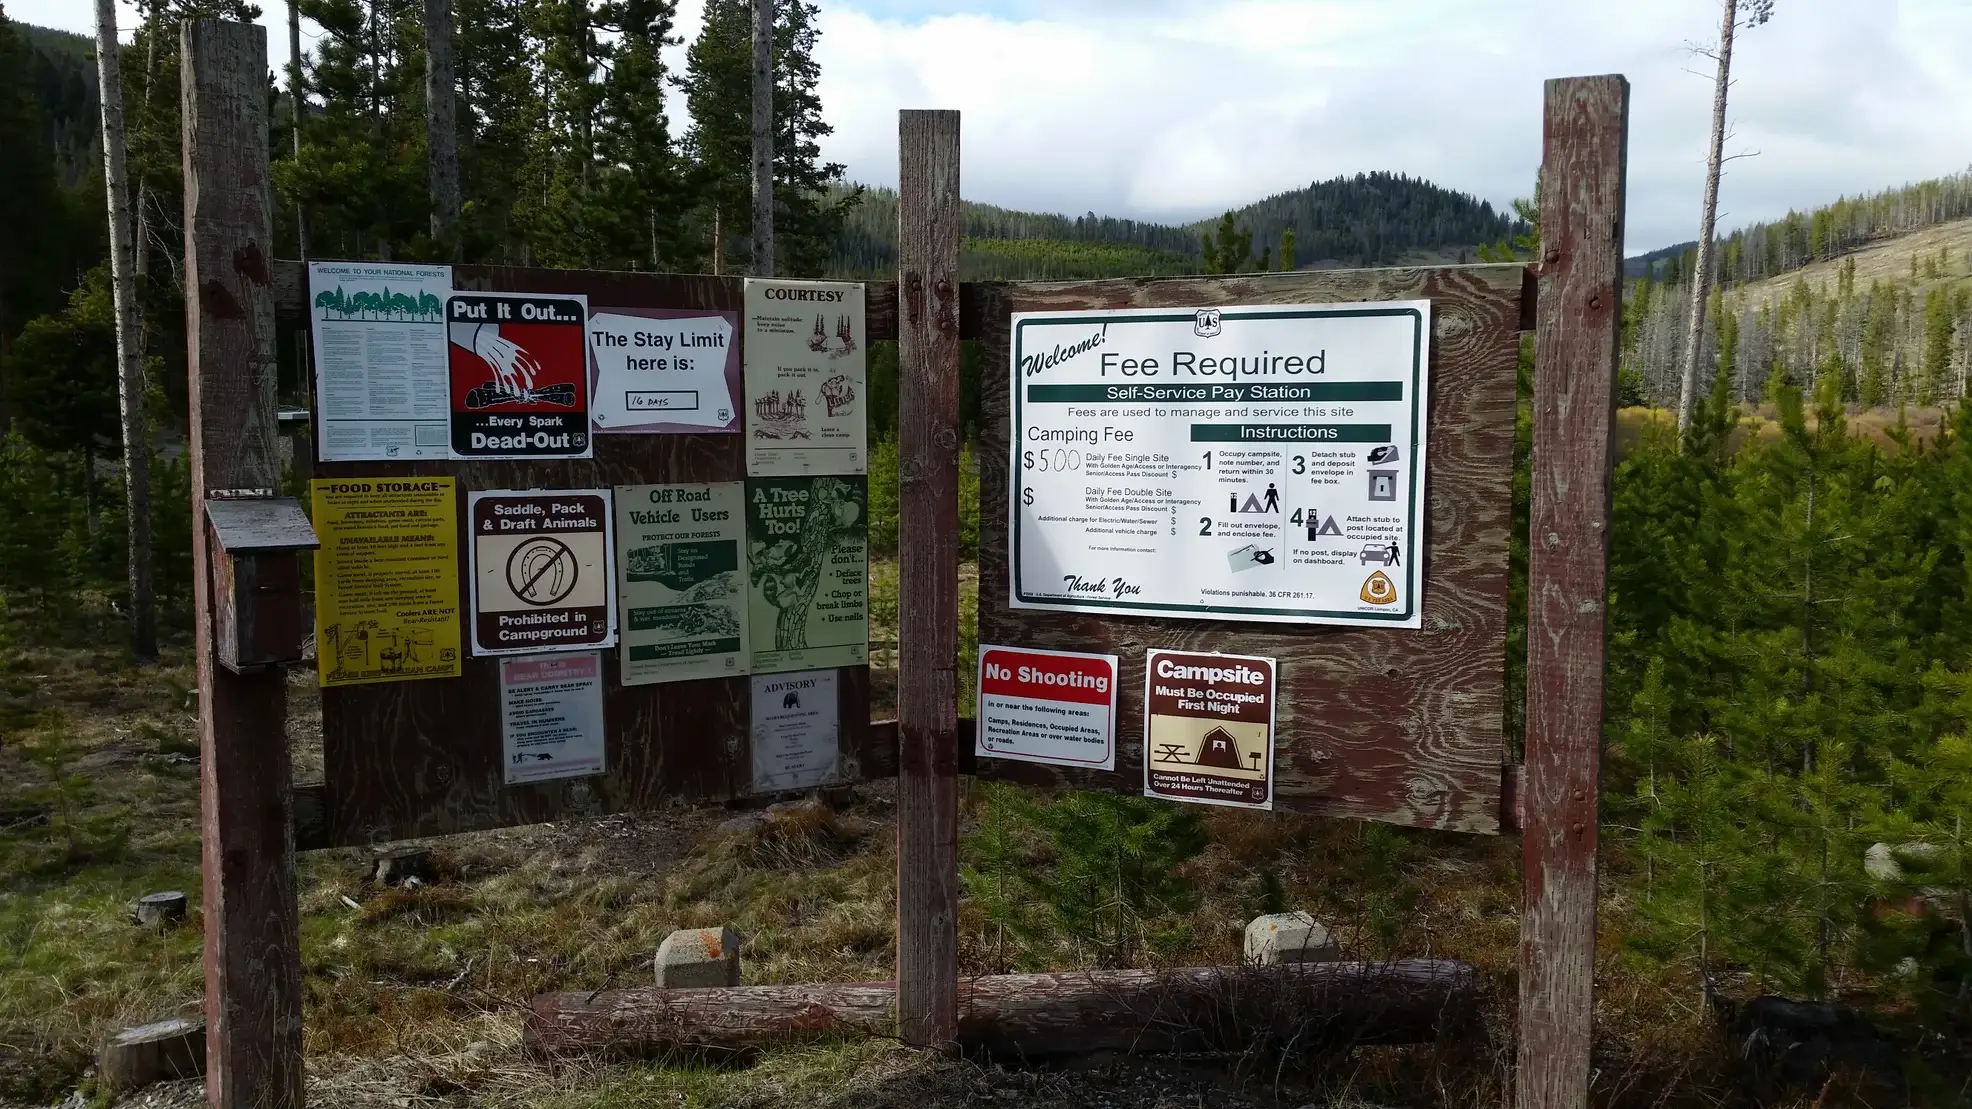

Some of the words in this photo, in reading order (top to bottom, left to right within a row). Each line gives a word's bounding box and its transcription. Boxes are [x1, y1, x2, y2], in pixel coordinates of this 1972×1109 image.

[765, 288, 844, 302] COURTESY
[453, 301, 487, 319] Put
[497, 303, 511, 319] It
[521, 303, 577, 321] Out...
[592, 331, 628, 347] The
[634, 331, 673, 351] Stay
[680, 332, 724, 347] Limit
[1022, 322, 1108, 377] Welcome!
[627, 355, 667, 370] here
[673, 355, 694, 370] is:
[1101, 352, 1159, 377] Fee
[1173, 350, 1325, 381] Required
[1107, 386, 1206, 399] Self-Service
[1211, 386, 1244, 401] Pay
[1250, 386, 1311, 399] Station
[648, 398, 669, 406] DAYS
[1068, 407, 1097, 417] Fees
[1100, 409, 1119, 417] are
[1122, 407, 1151, 417] used
[1155, 408, 1167, 417] to
[1171, 409, 1221, 419] manage
[1225, 407, 1248, 417] and
[1253, 408, 1299, 417] service
[1303, 407, 1326, 417] this
[1331, 407, 1354, 417] site
[476, 416, 523, 428] ...Every
[529, 416, 563, 428] Spark
[1028, 426, 1098, 444] Camping
[1104, 427, 1134, 441] Fee
[1241, 425, 1338, 439] Instructions
[471, 432, 570, 449] Dead-Out
[1024, 451, 1034, 471] $
[1086, 453, 1105, 462] Daily
[1107, 454, 1123, 462] Fee
[1125, 454, 1150, 463] Single
[1152, 454, 1169, 462] Site
[1202, 451, 1211, 470] 1
[1292, 455, 1306, 475] 3
[1311, 469, 1344, 477] envelope
[330, 484, 371, 494] FOOD
[376, 482, 439, 493] STORAGE
[753, 488, 767, 503] A
[770, 487, 809, 502] Tree
[649, 490, 673, 504] Off
[676, 488, 711, 503] Road
[494, 504, 546, 516] Saddle,
[552, 503, 585, 514] Pack
[629, 510, 680, 525] Vehicle
[691, 508, 729, 522] Users
[759, 503, 805, 519] Hurts
[483, 519, 493, 530] &
[500, 518, 536, 530] Draft
[543, 517, 597, 529] Animals
[1290, 508, 1303, 527] 4
[766, 519, 800, 534] Too!
[1199, 517, 1212, 536] 2
[642, 533, 673, 541] PROTECT
[691, 531, 720, 539] FORESTS
[831, 545, 863, 554] Please
[831, 554, 863, 564] don't...
[836, 569, 862, 578] Deface
[842, 577, 861, 585] trees
[831, 590, 851, 599] Chop
[1063, 575, 1106, 593] Thank
[1112, 577, 1141, 599] You
[1231, 590, 1268, 598] punishable.
[817, 602, 840, 610] break
[841, 600, 863, 608] limbs
[396, 609, 421, 618] Coolers
[499, 612, 569, 626] Prohibited
[575, 612, 587, 622] in
[828, 614, 843, 622] Use
[845, 613, 863, 621] nails
[499, 626, 587, 643] Campground
[986, 663, 1011, 680] No
[1018, 666, 1108, 693] Shooting
[1157, 660, 1265, 685] Campsite
[764, 679, 817, 693] ADVISORY
[1155, 686, 1185, 697] Must
[1188, 689, 1204, 699] Be
[1206, 689, 1264, 704] Occupied
[1035, 705, 1066, 715] following
[1178, 699, 1205, 711] First
[1207, 701, 1240, 715] Night
[988, 717, 1010, 726] Camps,
[1012, 719, 1048, 730] Residences,
[1050, 723, 1078, 733] Occupied
[1080, 726, 1100, 735] Areas,
[988, 726, 1020, 736] Recreation
[1083, 736, 1104, 744] bodies
[1153, 773, 1179, 782] Cannot
[1180, 775, 1191, 783] Be
[1191, 776, 1206, 784] Left
[1207, 778, 1250, 789] Unattended
[1153, 781, 1170, 789] Over
[1171, 782, 1180, 790] 24
[1182, 784, 1204, 792] Hours
[1205, 785, 1244, 796] Thereafter
